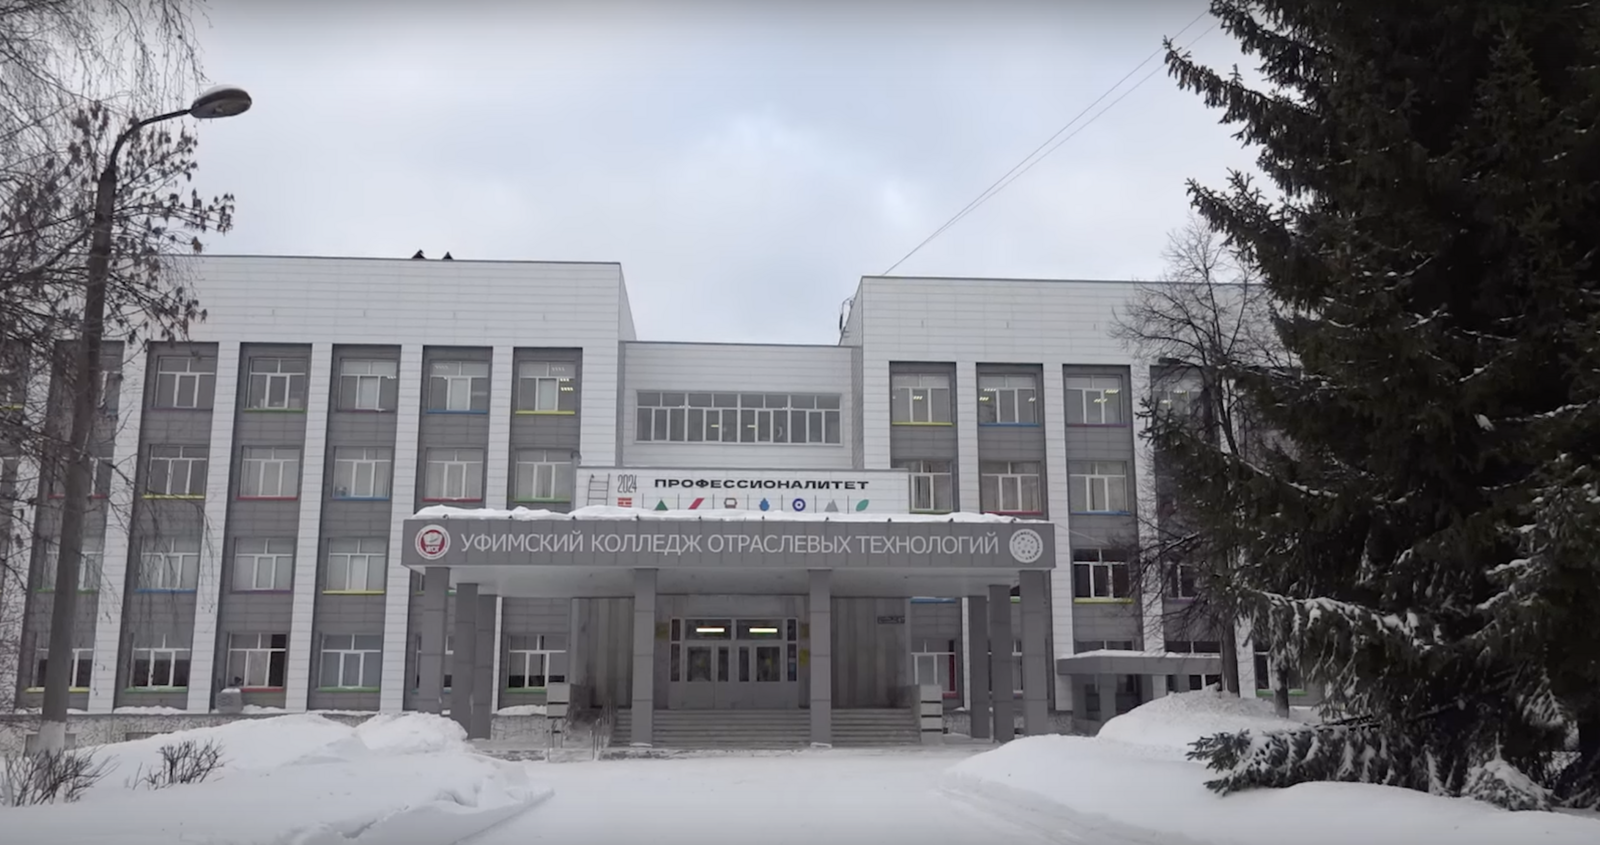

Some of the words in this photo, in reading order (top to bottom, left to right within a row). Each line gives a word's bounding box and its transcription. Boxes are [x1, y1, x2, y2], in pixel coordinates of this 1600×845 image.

[617, 474, 637, 493] 2024
[654, 478, 869, 490] ПРОФЕССИОНАЛИТЕТ
[460, 530, 584, 552] УФИМСКИЙ
[591, 533, 703, 556] КОЛЛЕДЖ
[707, 533, 852, 554] ОТРАСЛЕВЫХ
[855, 531, 999, 554] ТЕХНОЛОГИЙ
